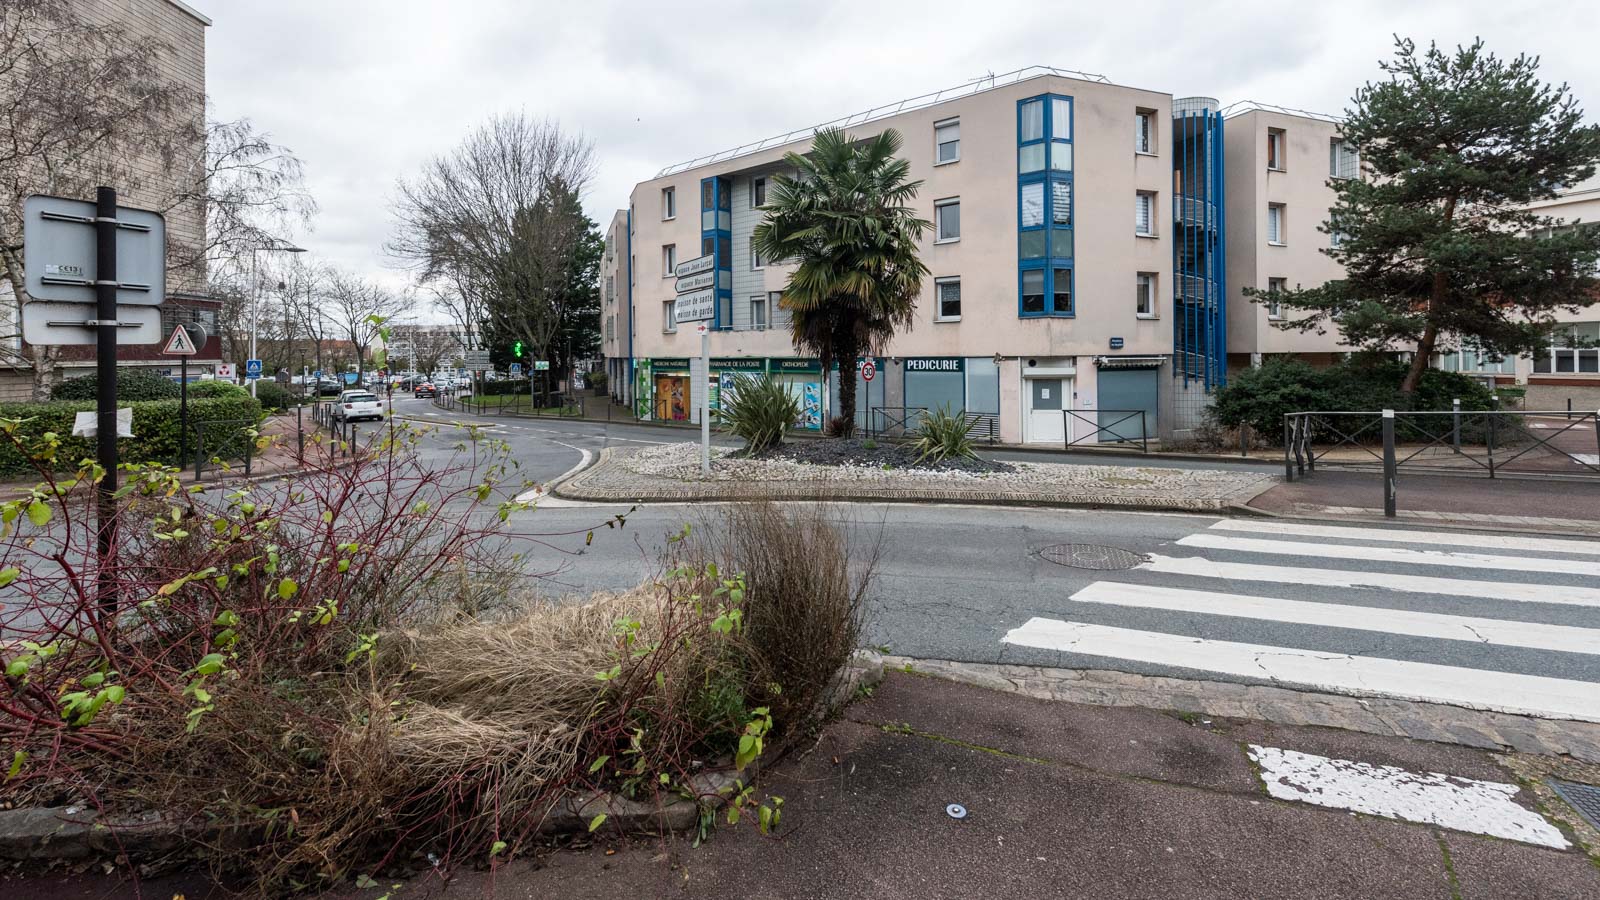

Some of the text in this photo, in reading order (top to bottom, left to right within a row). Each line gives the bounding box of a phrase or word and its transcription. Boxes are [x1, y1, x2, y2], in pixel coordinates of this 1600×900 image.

[700, 293, 712, 304] santé
[700, 306, 712, 318] garde
[907, 360, 958, 370] PEDICURIE
[864, 367, 872, 376] 30
